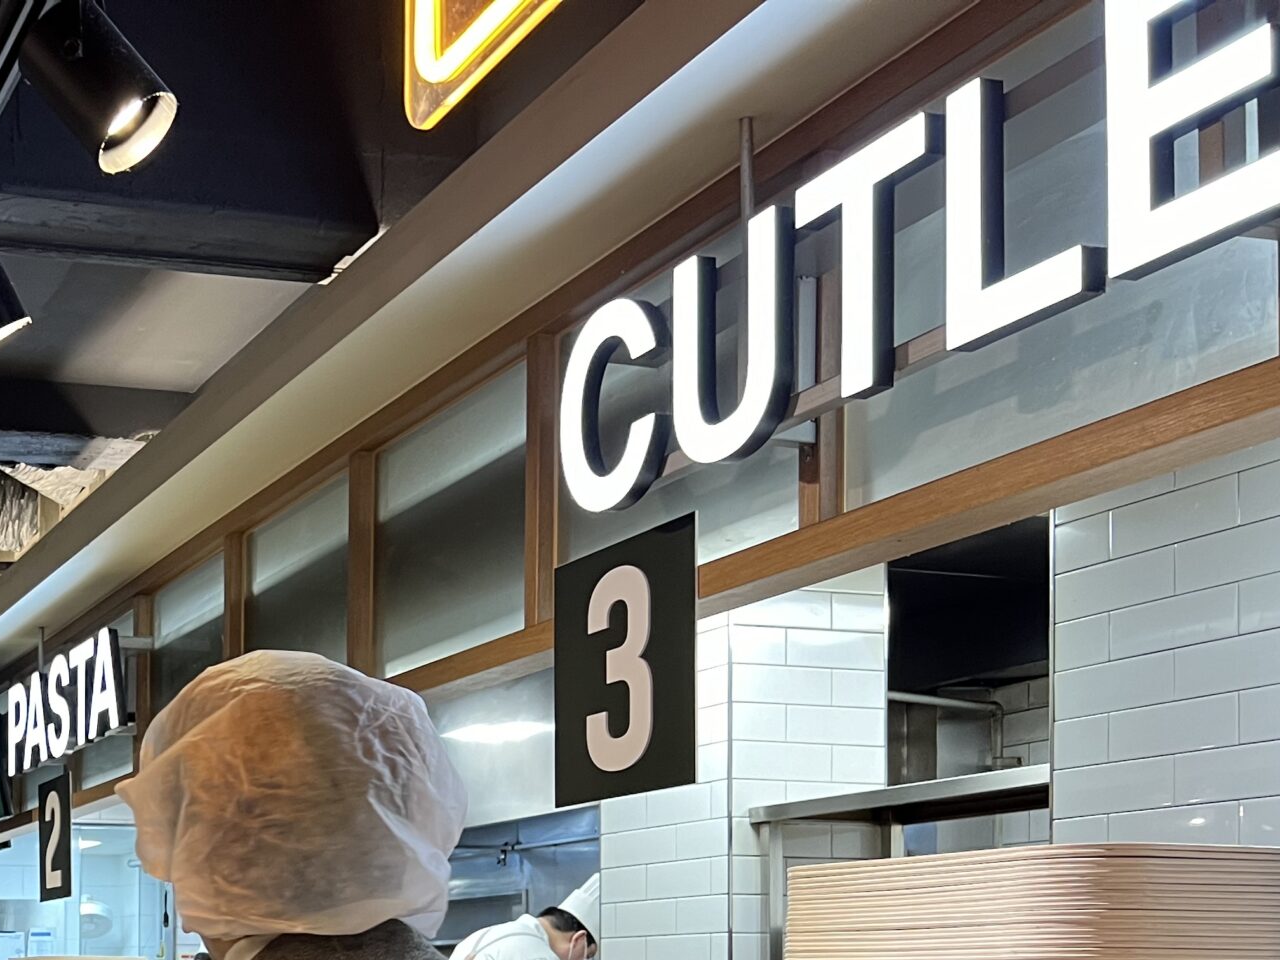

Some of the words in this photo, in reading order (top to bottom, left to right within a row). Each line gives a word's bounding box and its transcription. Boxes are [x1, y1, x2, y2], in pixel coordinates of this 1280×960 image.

[7, 626, 119, 778] PASTA
[585, 563, 655, 773] 3
[44, 790, 63, 890] 2
